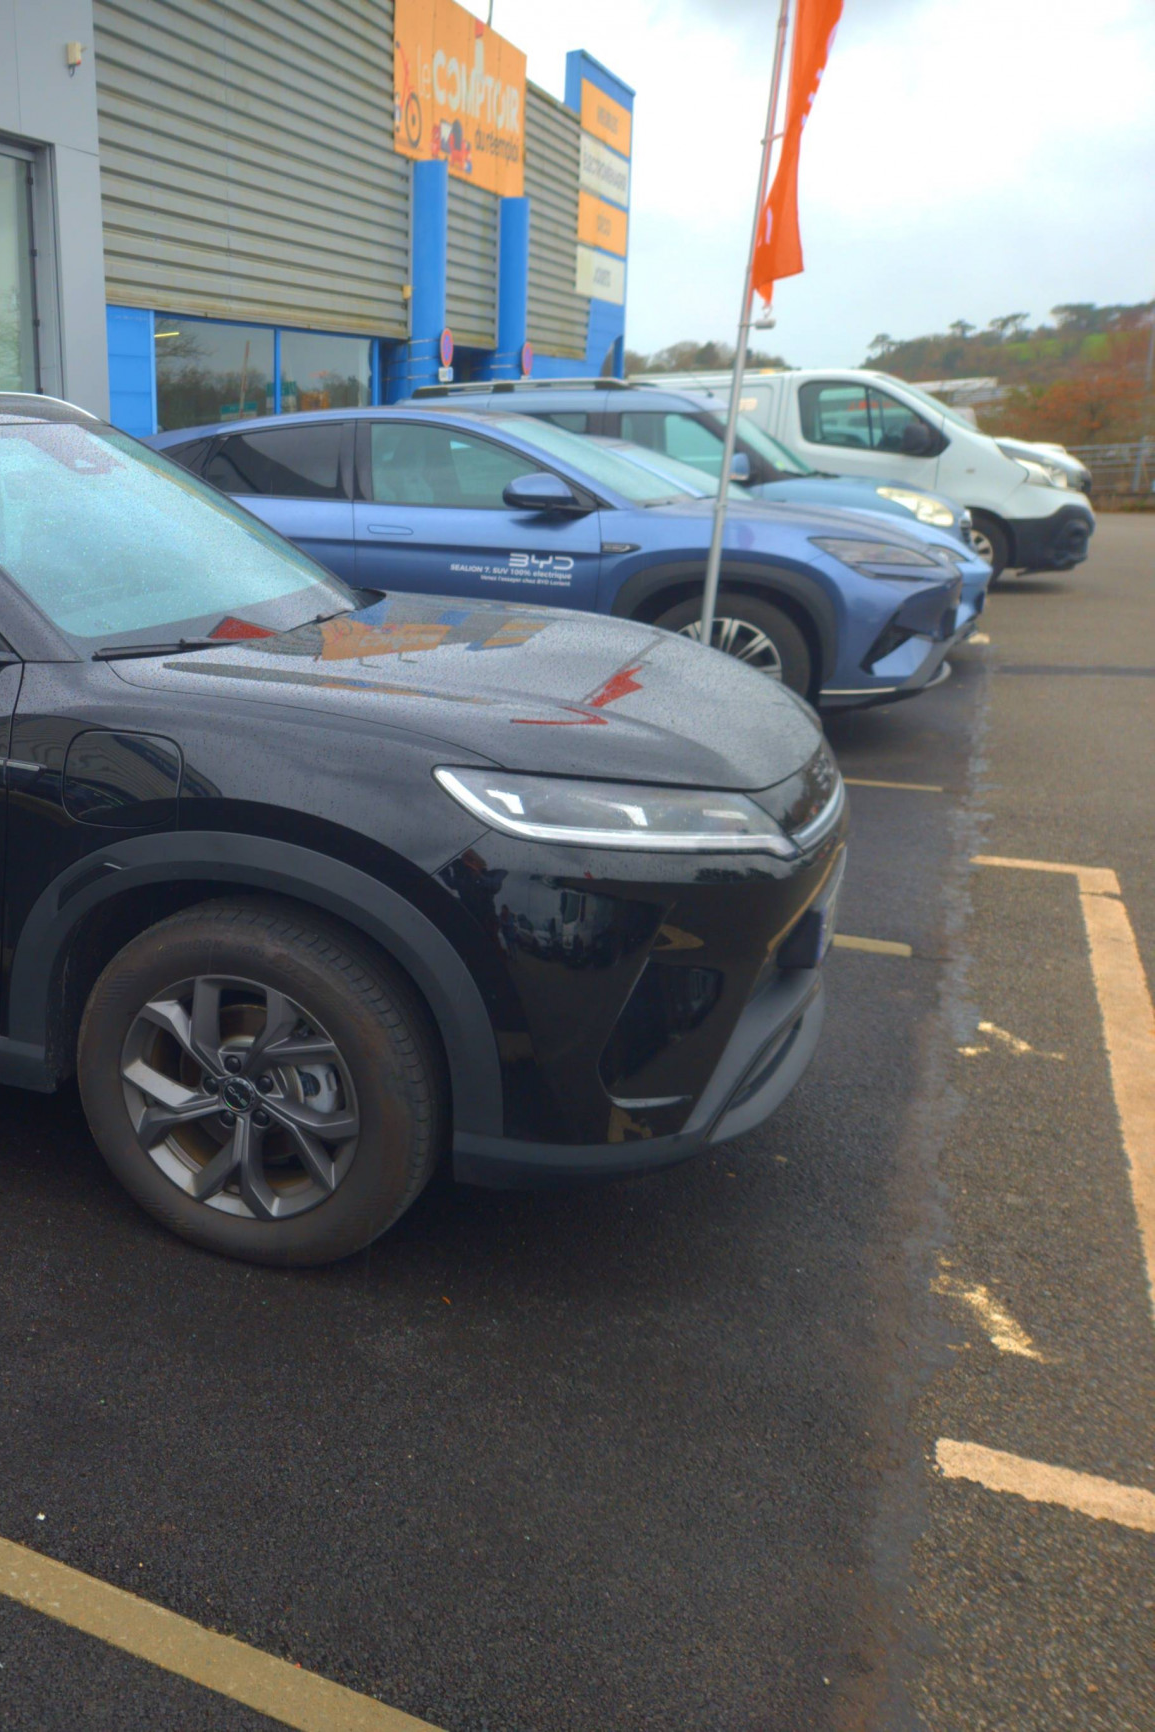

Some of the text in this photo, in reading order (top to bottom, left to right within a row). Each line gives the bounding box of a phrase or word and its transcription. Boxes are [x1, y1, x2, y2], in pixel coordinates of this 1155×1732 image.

[416, 39, 520, 134] le COMPTOIR
[450, 563, 483, 573] SEALION
[493, 567, 508, 575] SUV
[510, 568, 531, 577] 100%
[509, 553, 574, 571] BYD
